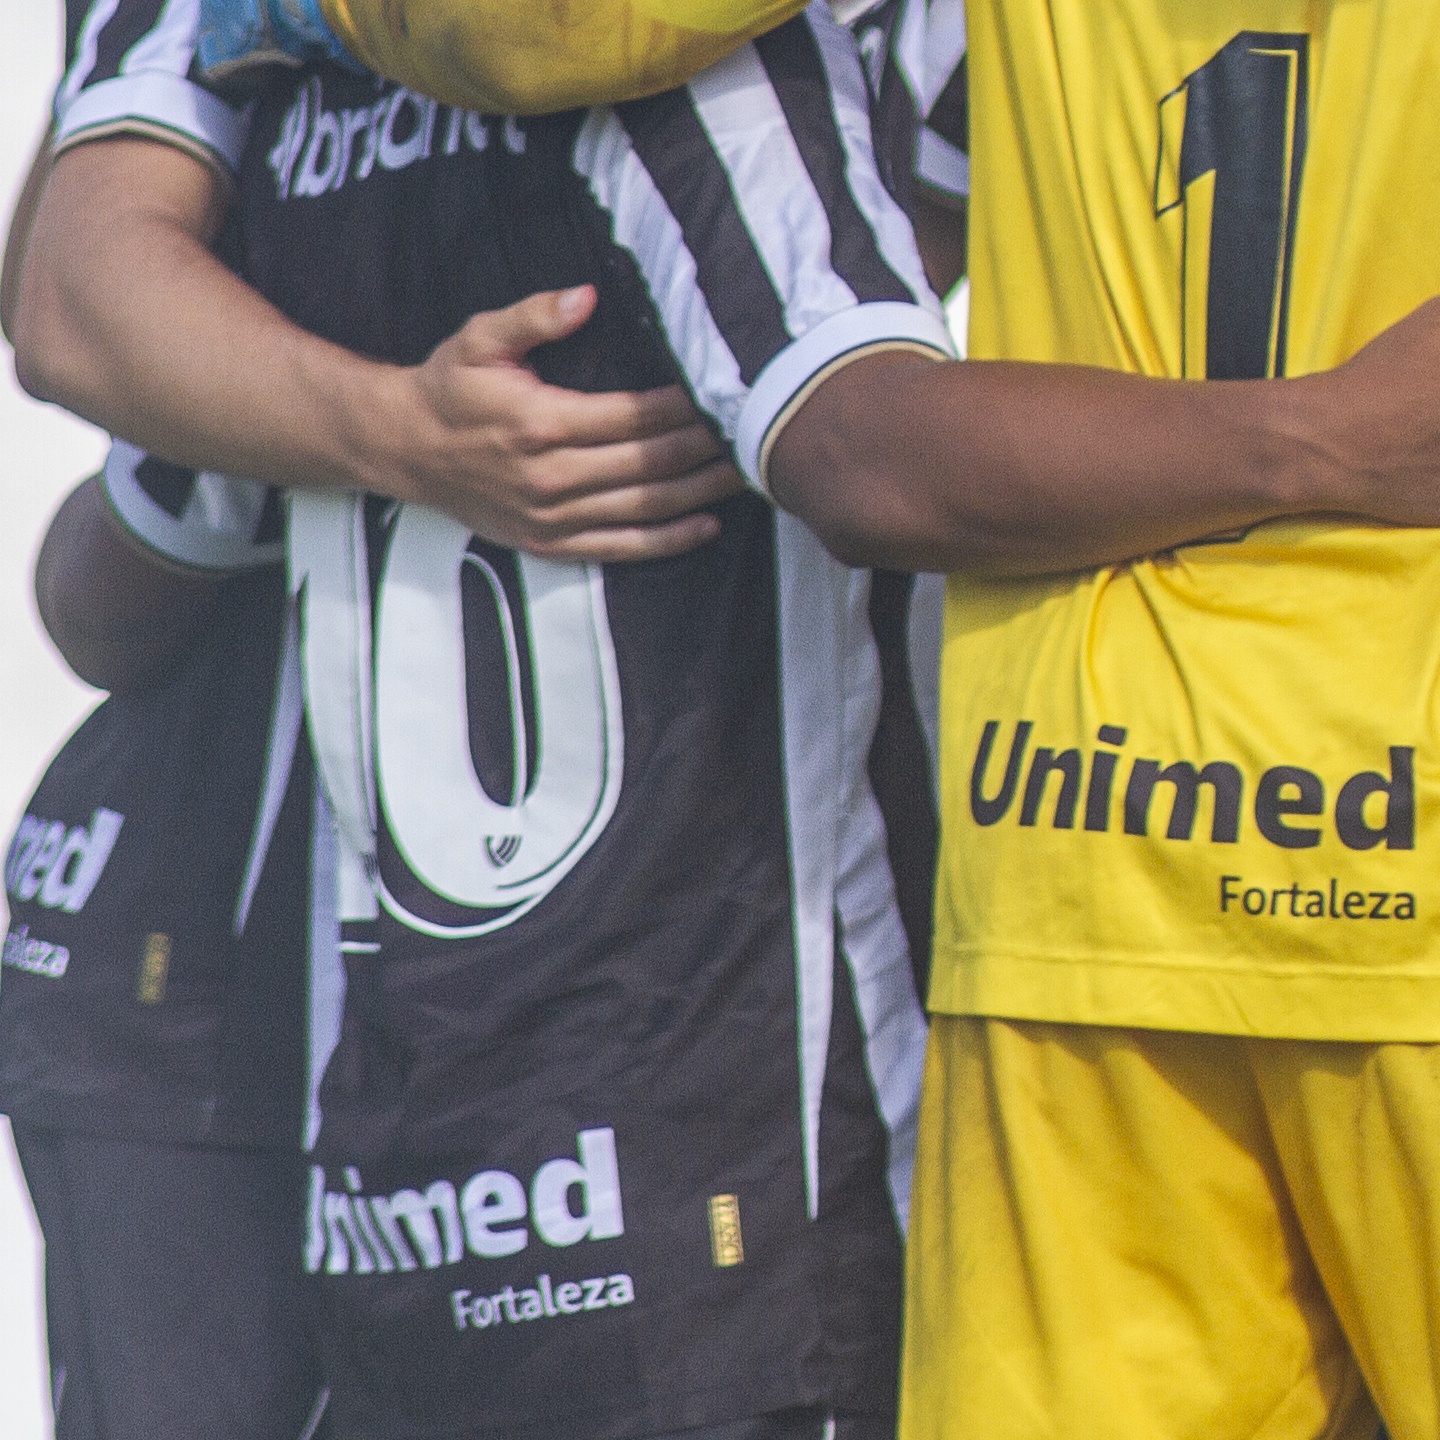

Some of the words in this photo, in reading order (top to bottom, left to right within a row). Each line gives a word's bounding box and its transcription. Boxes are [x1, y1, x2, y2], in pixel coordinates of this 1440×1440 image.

[1155, 30, 1310, 382] 1
[288, 490, 625, 953] 10
[968, 719, 1417, 852] Unimed
[1219, 874, 1418, 921] Fortaleza
[451, 1273, 638, 1332] Fortaleza
